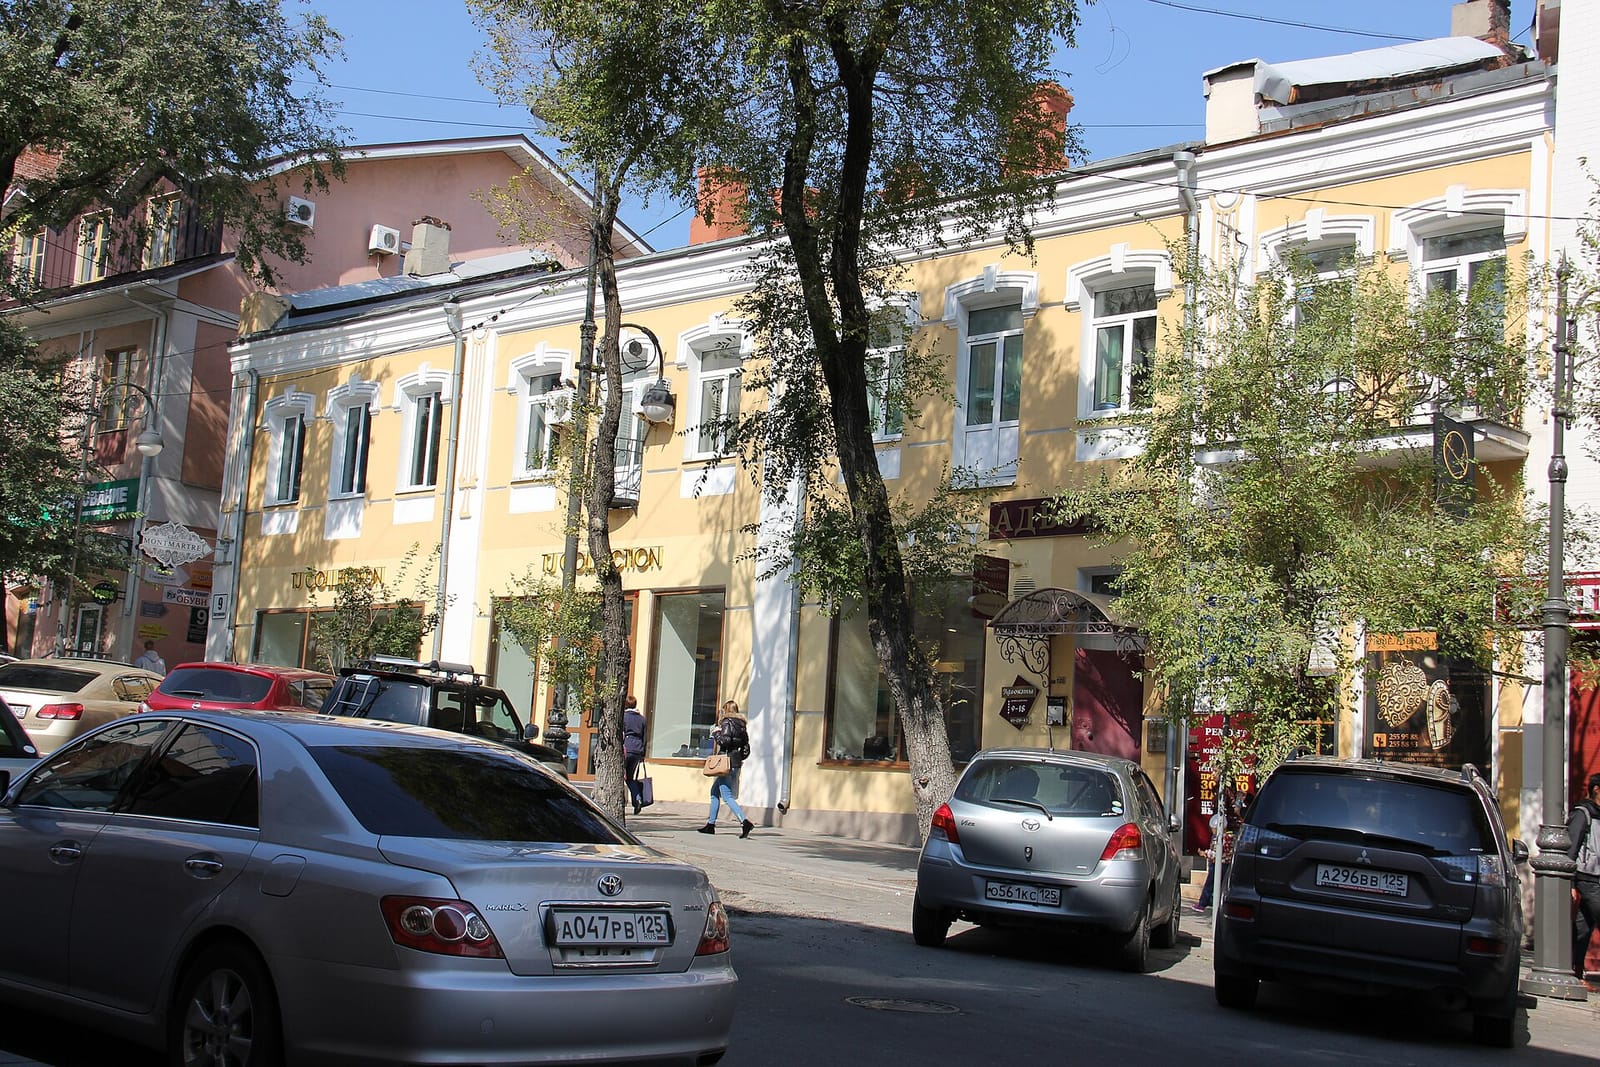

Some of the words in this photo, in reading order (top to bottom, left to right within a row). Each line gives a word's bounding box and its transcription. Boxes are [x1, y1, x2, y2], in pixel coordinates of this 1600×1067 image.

[143, 537, 201, 552] MONTMARTRE
[217, 596, 224, 611] 9
[196, 609, 208, 625] 9
[1321, 867, 1379, 887] А296ВВ
[1382, 873, 1404, 887] 125
[990, 885, 1037, 901] О561КС
[1040, 888, 1057, 900] 125
[562, 915, 635, 939] А047РВ
[637, 915, 664, 934] 125
[643, 933, 657, 941] RUS
